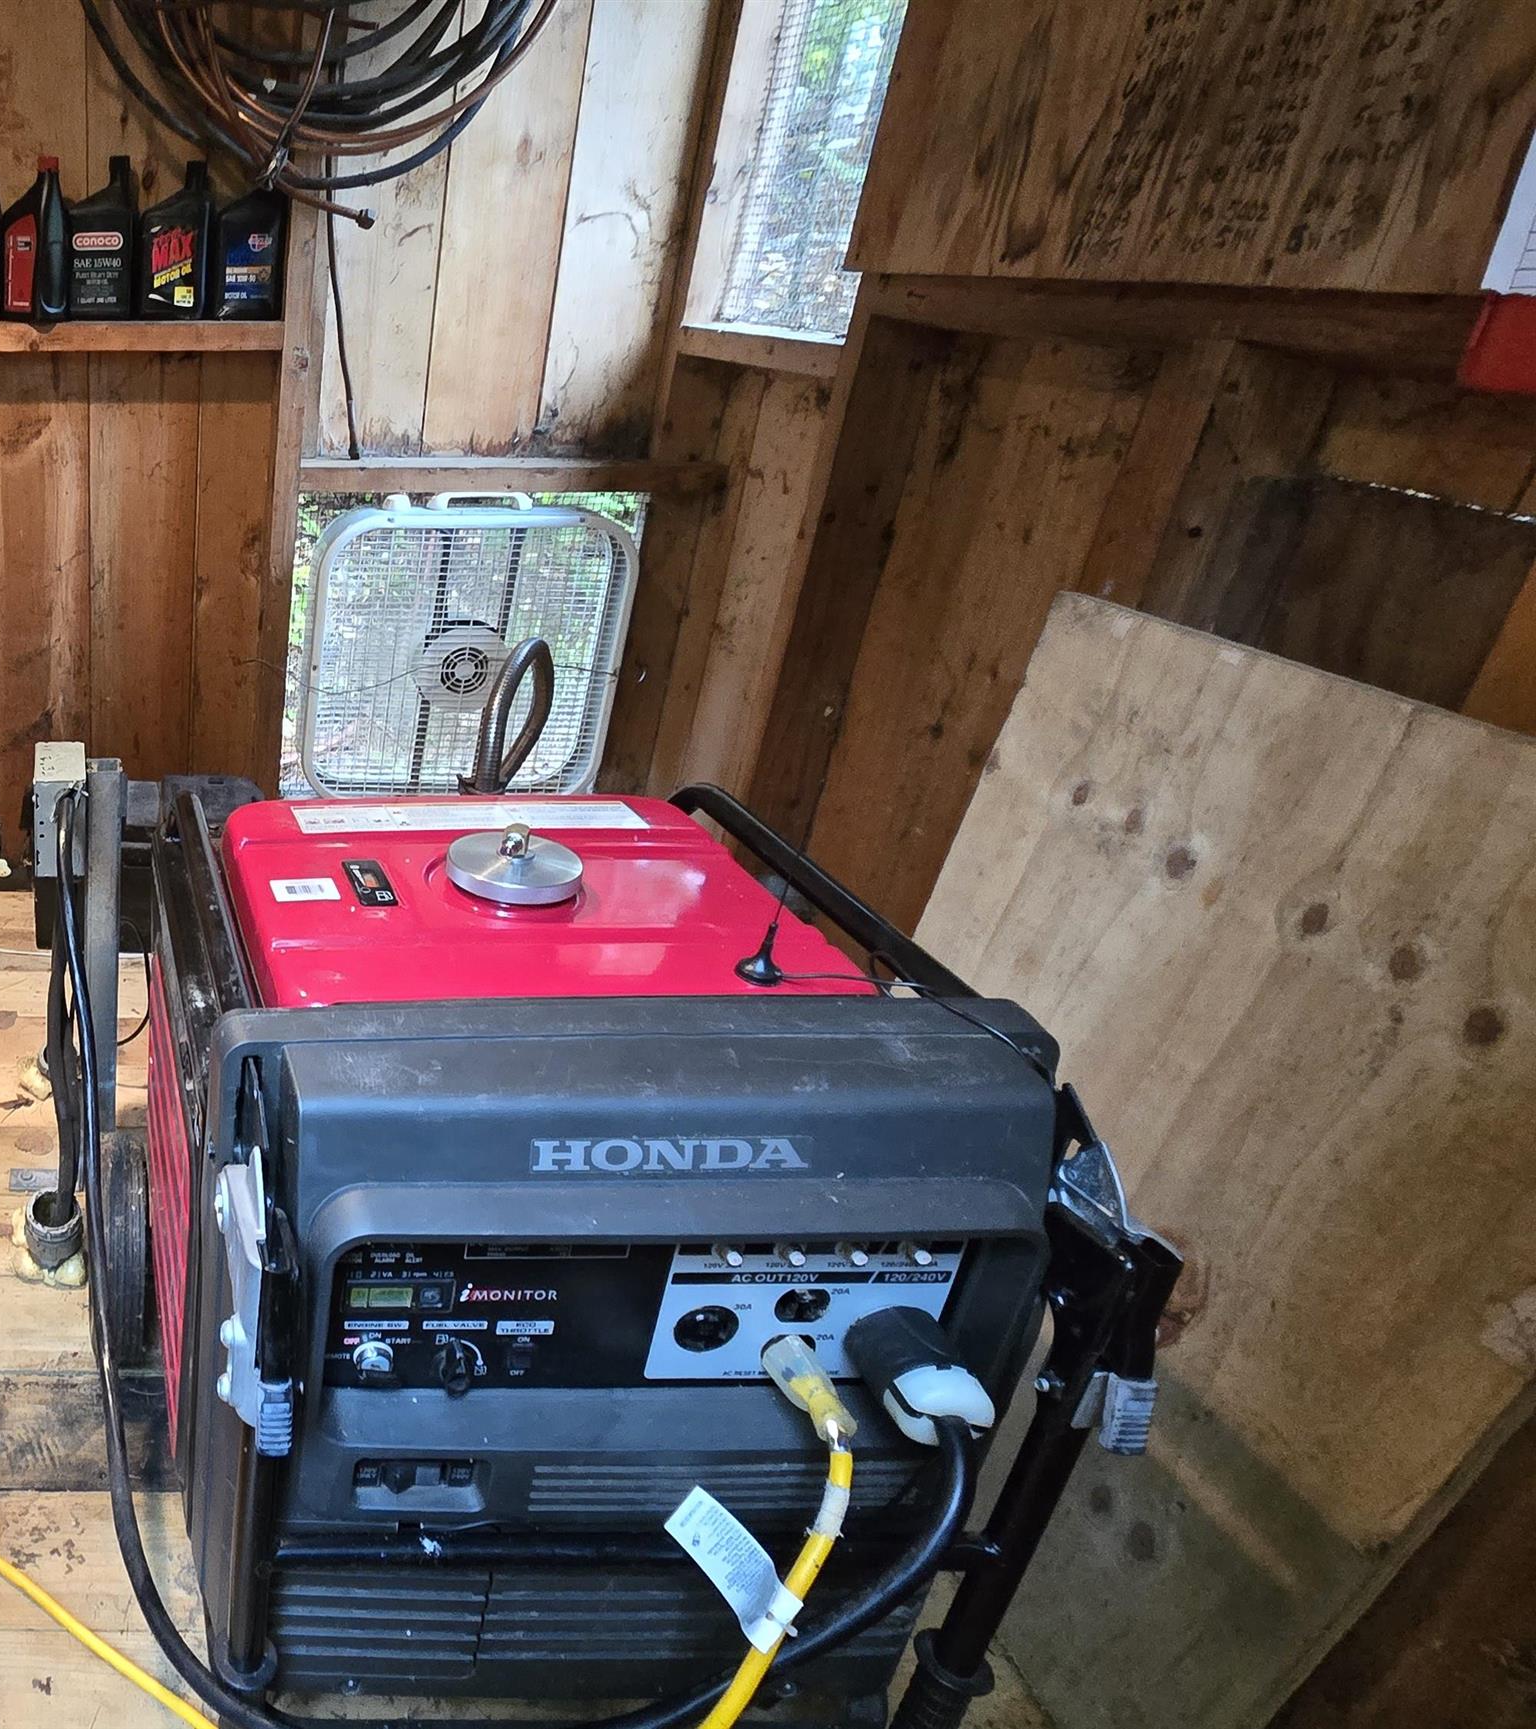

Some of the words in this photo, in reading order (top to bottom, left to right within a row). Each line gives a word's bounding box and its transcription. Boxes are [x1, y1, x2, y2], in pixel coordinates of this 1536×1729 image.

[73, 257, 93, 268] SAE
[154, 268, 180, 288] MOTOR
[181, 263, 192, 276] OIL
[532, 1138, 810, 1171] HONDA
[731, 1273, 753, 1283] AC
[884, 1272, 946, 1282] 120/240V
[385, 1337, 412, 1345] START
